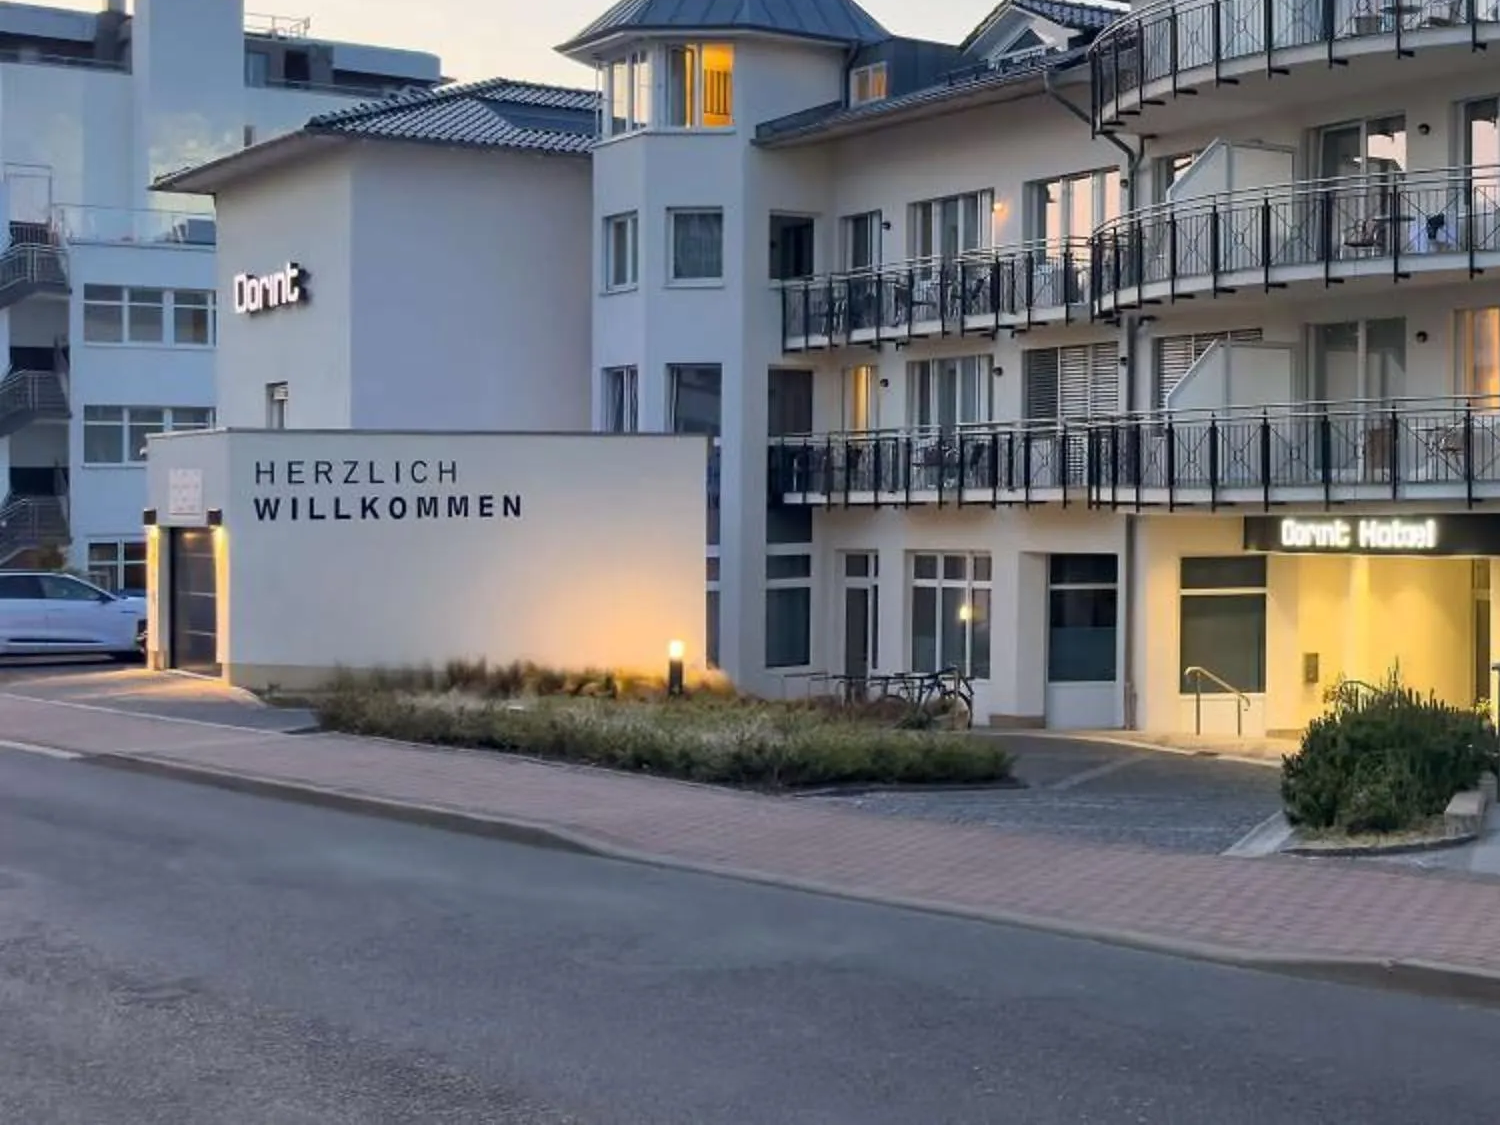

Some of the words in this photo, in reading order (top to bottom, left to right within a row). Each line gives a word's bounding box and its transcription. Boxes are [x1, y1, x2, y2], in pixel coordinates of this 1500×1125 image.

[234, 262, 300, 313] Dorint
[254, 460, 457, 485] HERZLICH
[253, 494, 521, 521] WILLKOMMEN
